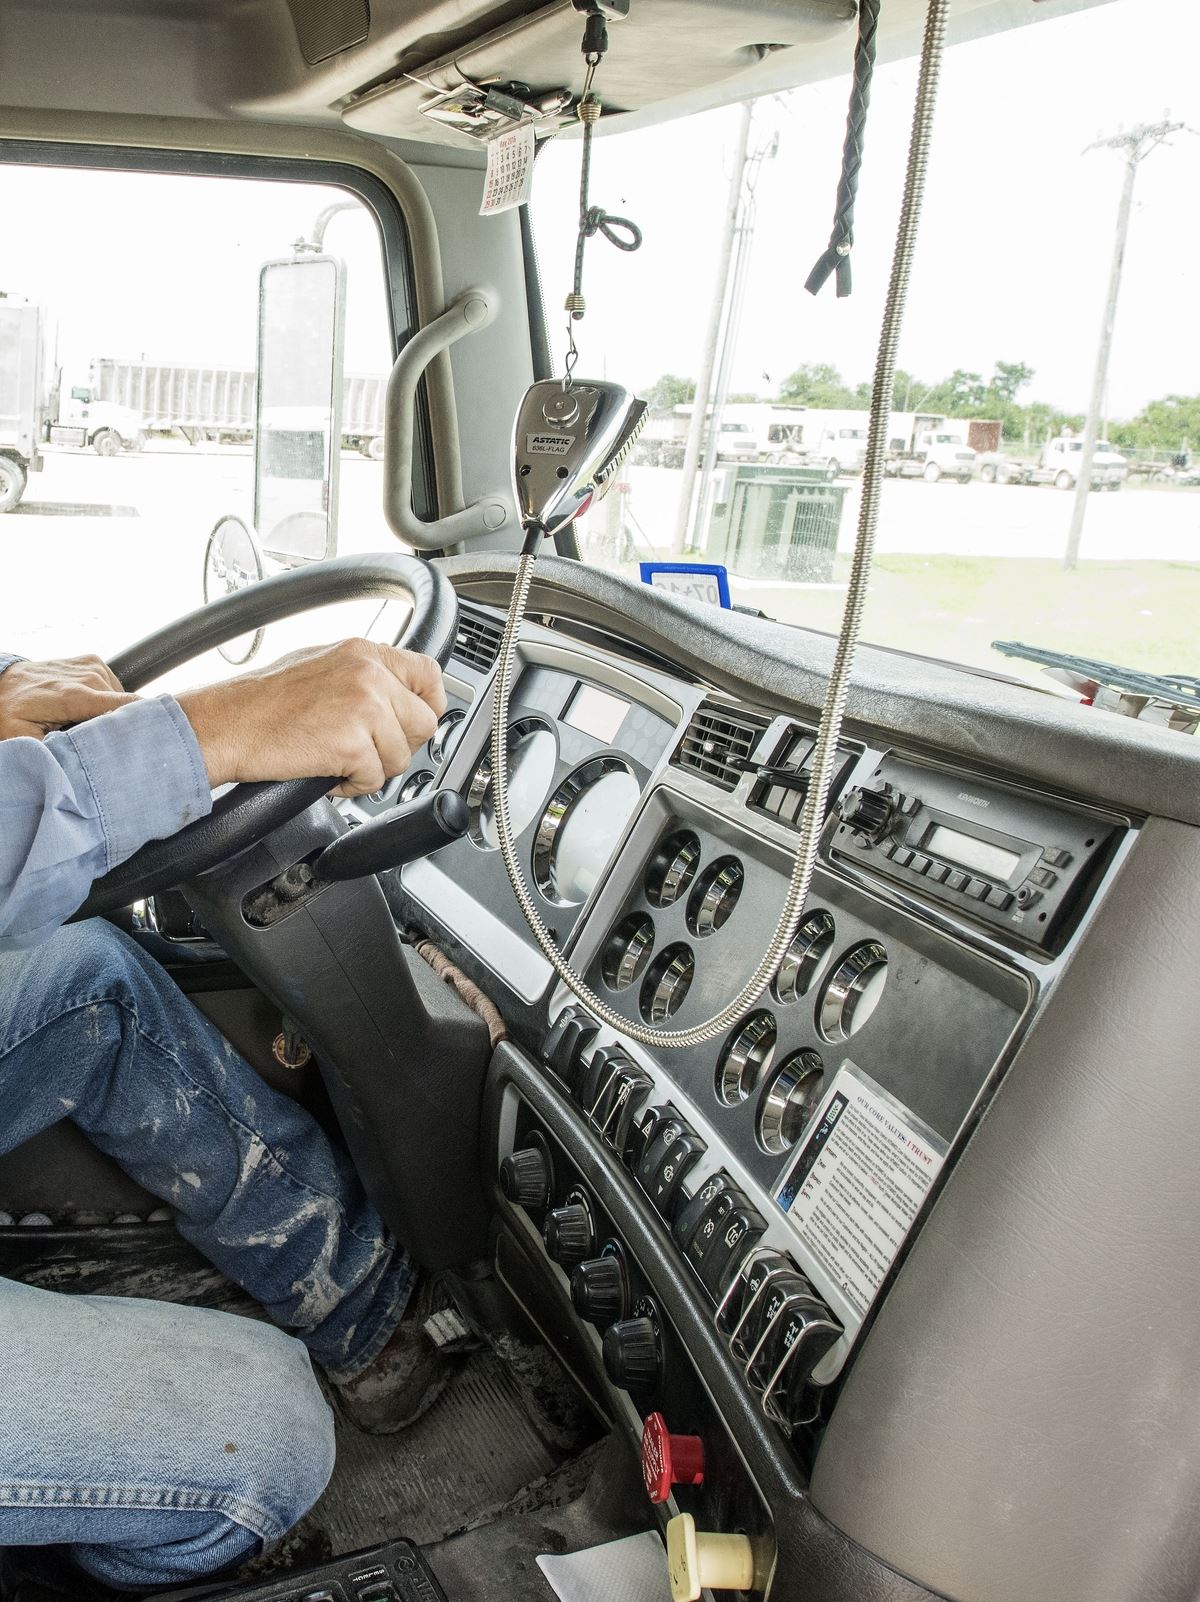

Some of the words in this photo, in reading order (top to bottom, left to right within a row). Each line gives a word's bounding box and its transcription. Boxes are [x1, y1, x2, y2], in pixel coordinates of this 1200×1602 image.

[532, 437, 570, 445] ASTATIC
[857, 1096, 870, 1110] OUR
[869, 1106, 884, 1122] CORE
[884, 1120, 907, 1144] VALUES:
[911, 1144, 932, 1166] TRUST
